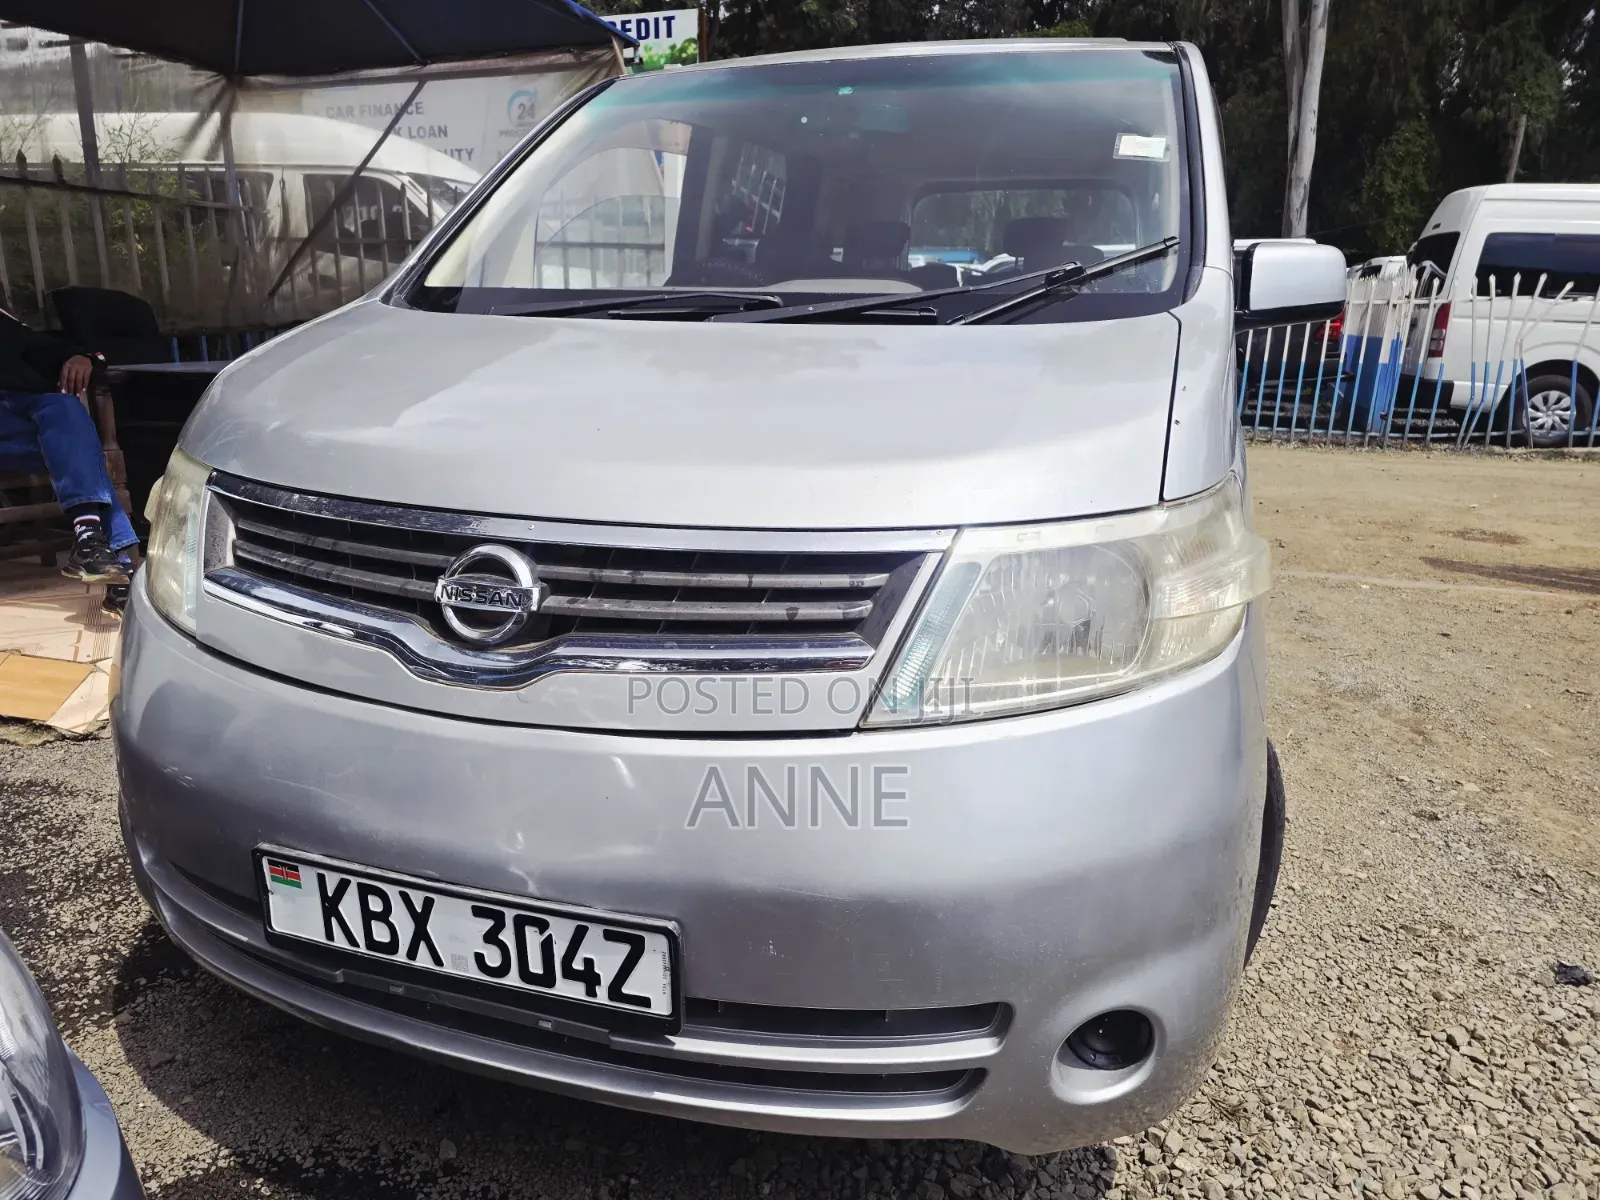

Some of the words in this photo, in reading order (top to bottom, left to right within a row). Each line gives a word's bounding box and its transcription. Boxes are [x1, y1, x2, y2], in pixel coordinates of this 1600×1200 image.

[326, 105, 356, 119] CAR
[517, 103, 535, 120] 24
[408, 125, 448, 140] LOAN
[440, 584, 523, 607] NISSAN
[316, 871, 444, 967] KBX
[471, 904, 651, 1009] 304Z
